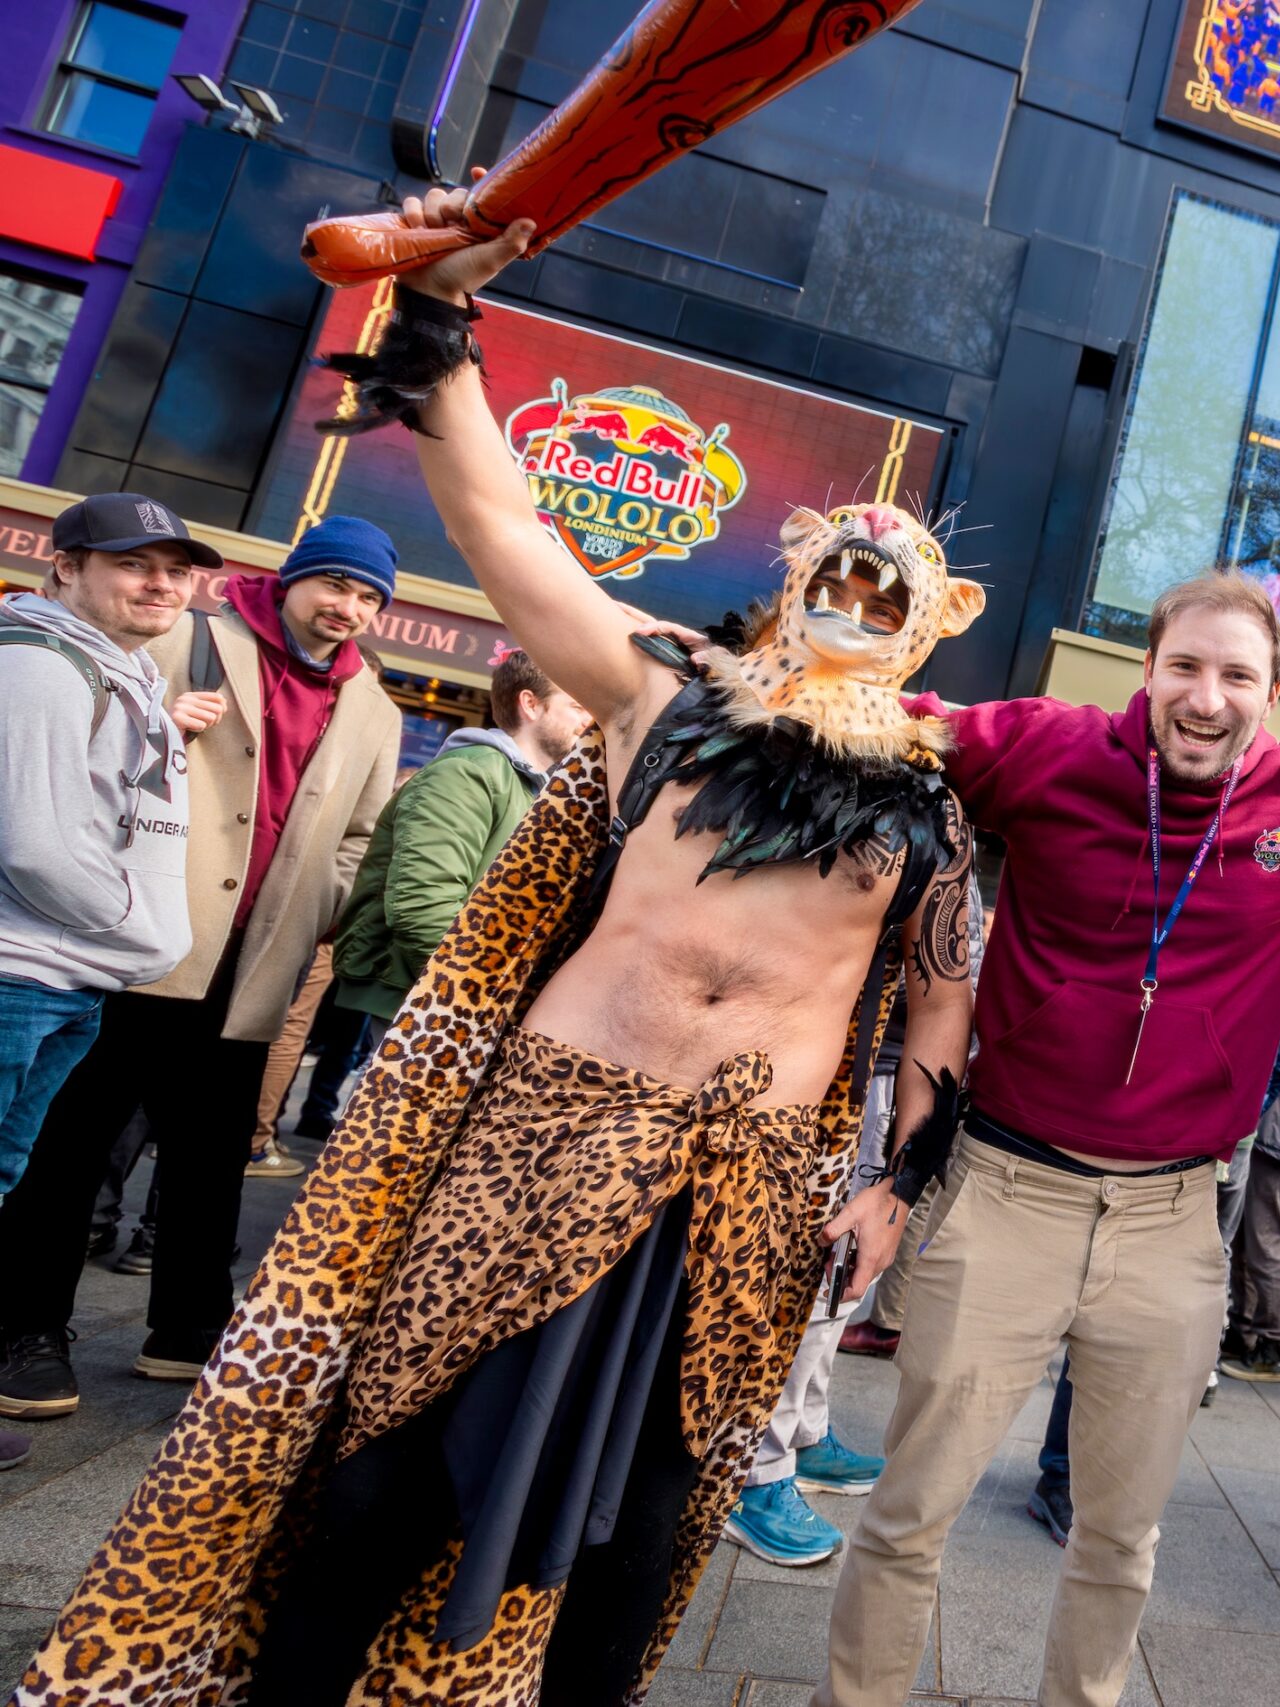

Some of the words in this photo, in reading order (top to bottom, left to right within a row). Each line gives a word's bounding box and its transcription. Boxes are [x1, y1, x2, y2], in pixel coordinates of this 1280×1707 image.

[543, 440, 623, 488] Red
[622, 462, 702, 509] Bull
[527, 477, 703, 545] WOLOLO
[563, 516, 648, 546] LONDINIUM
